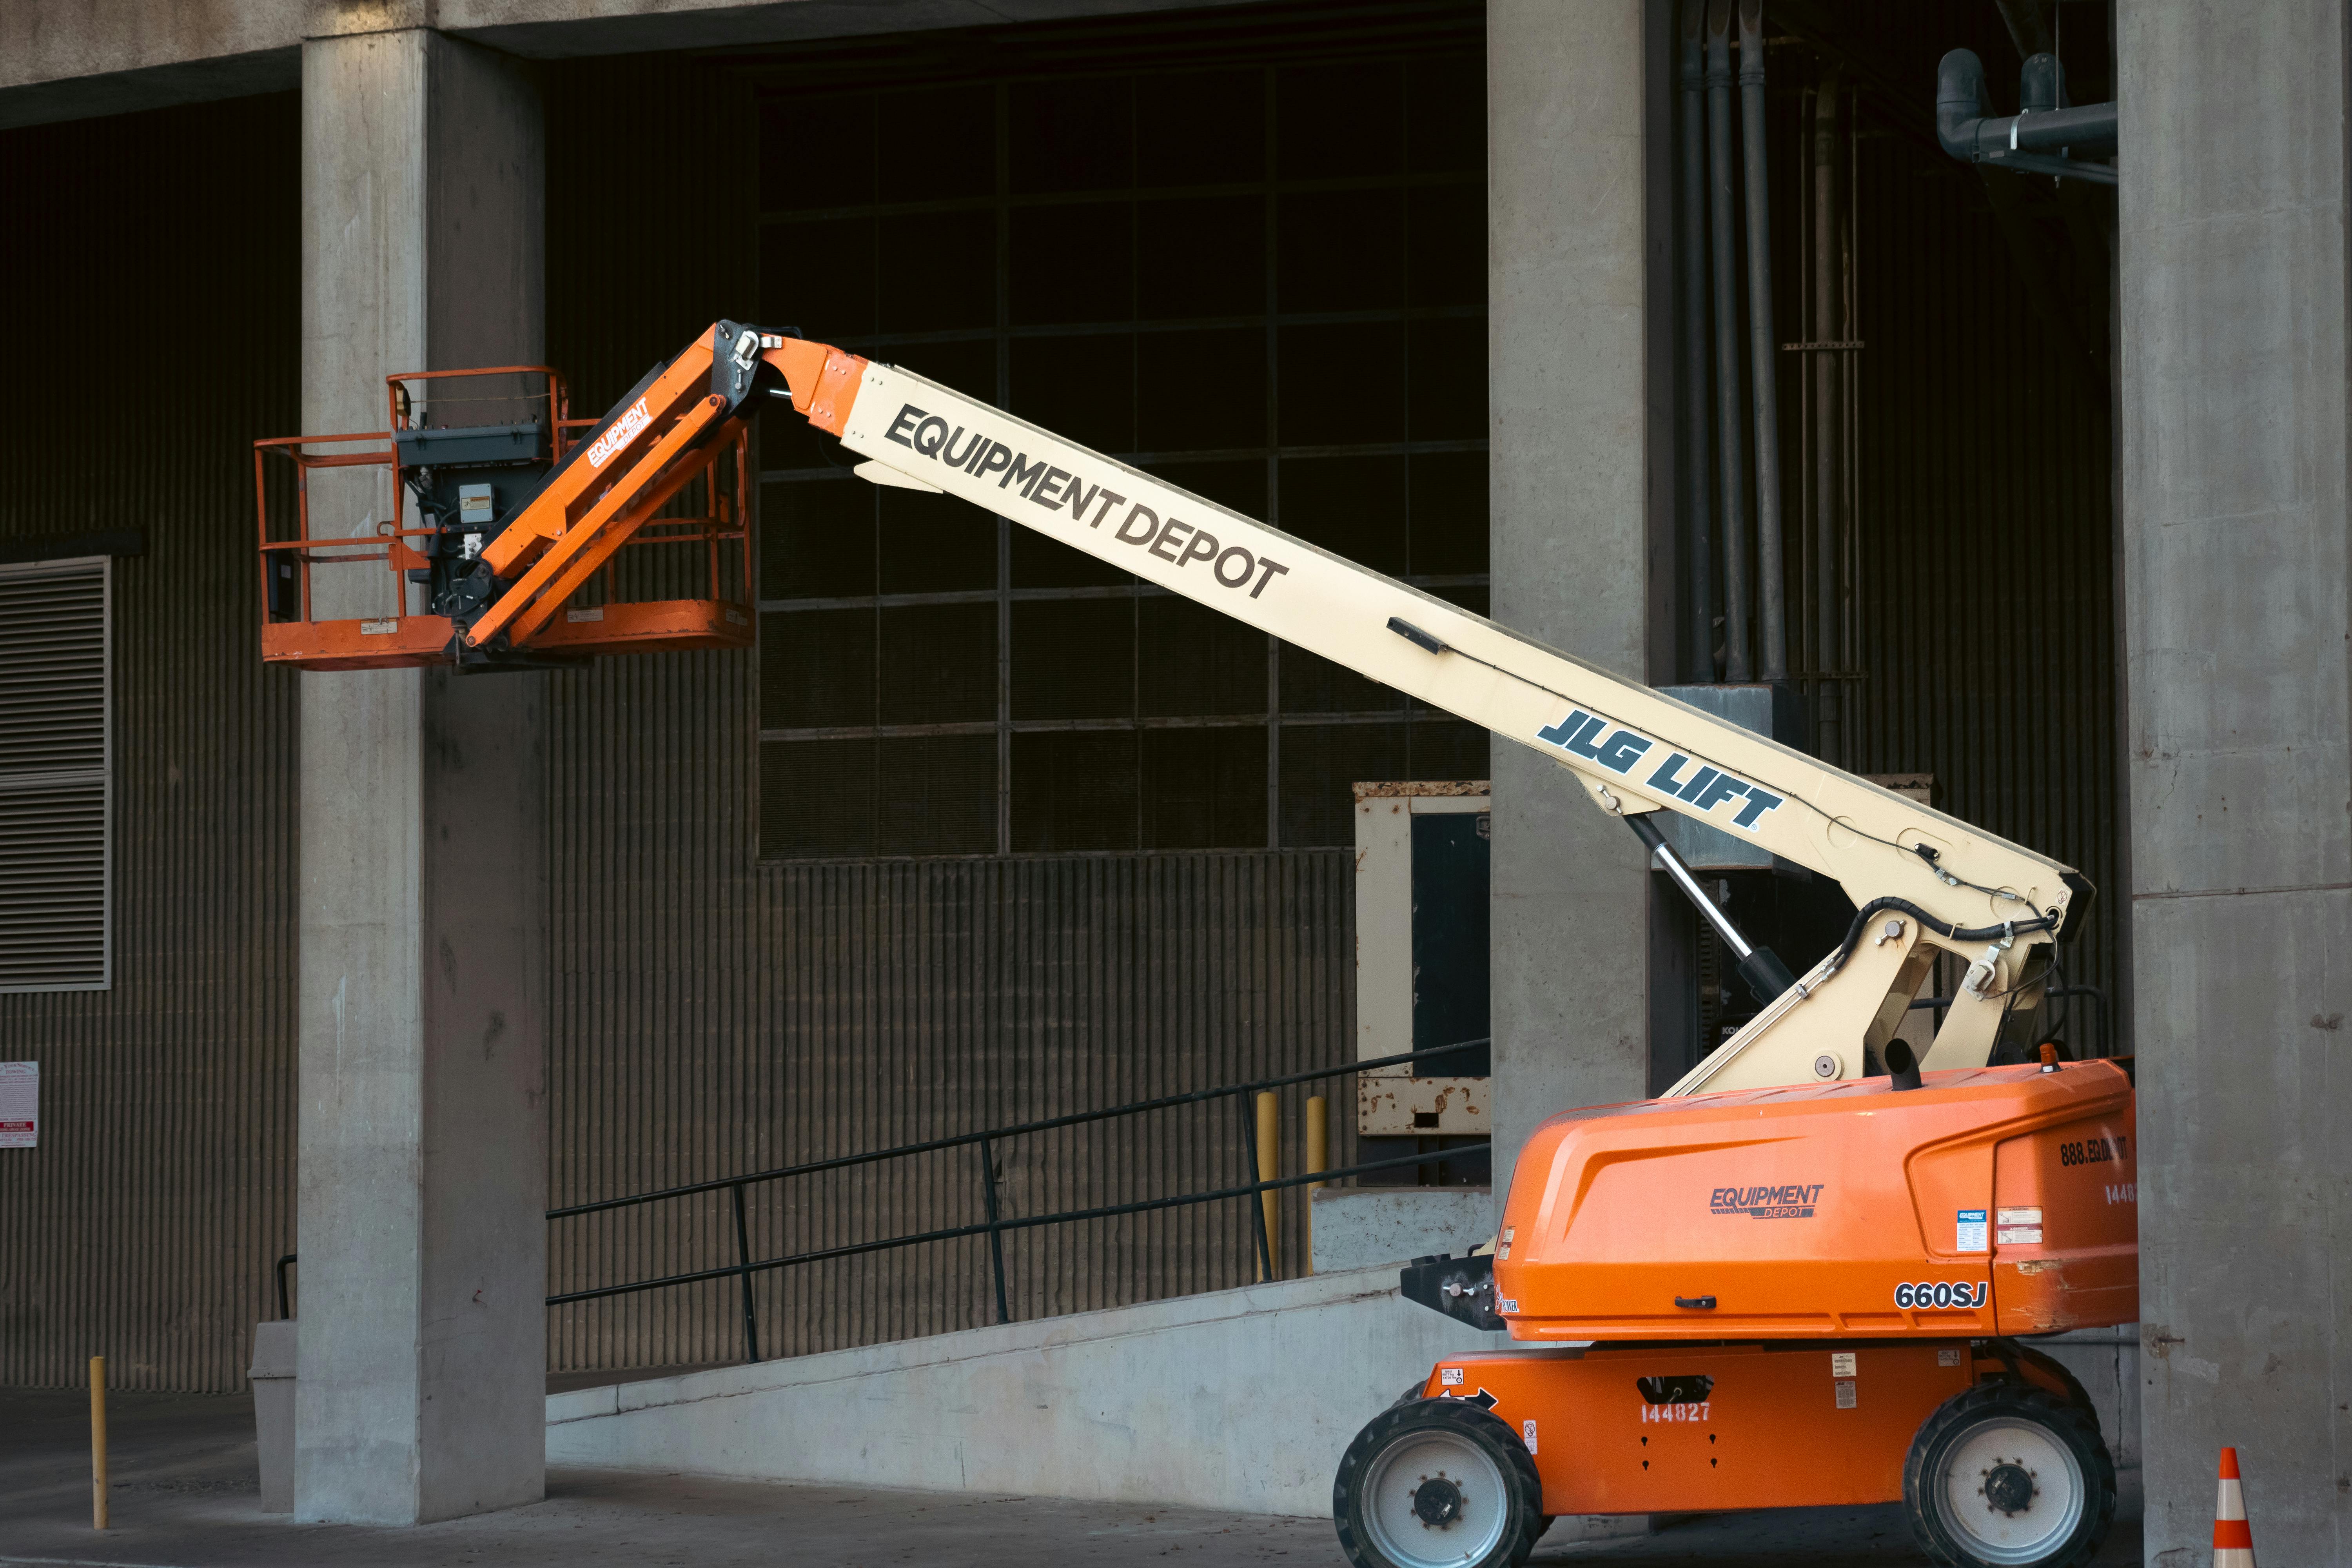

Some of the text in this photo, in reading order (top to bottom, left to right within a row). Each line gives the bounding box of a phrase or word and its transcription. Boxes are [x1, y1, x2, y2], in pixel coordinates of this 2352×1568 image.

[587, 397, 648, 466] EQUIPMENT
[623, 420, 644, 443] DEPOT
[884, 403, 1290, 599] EQUIPMENT DEPOT
[1534, 708, 1786, 830] JLG LIFT
[1710, 1184, 1824, 1210] EQUIPMENT
[1764, 1207, 1803, 1218] DEPOT
[1502, 1300, 1517, 1312] POWER
[1895, 1282, 1987, 1308] 660SJ
[1641, 1402, 1710, 1423] 144827
